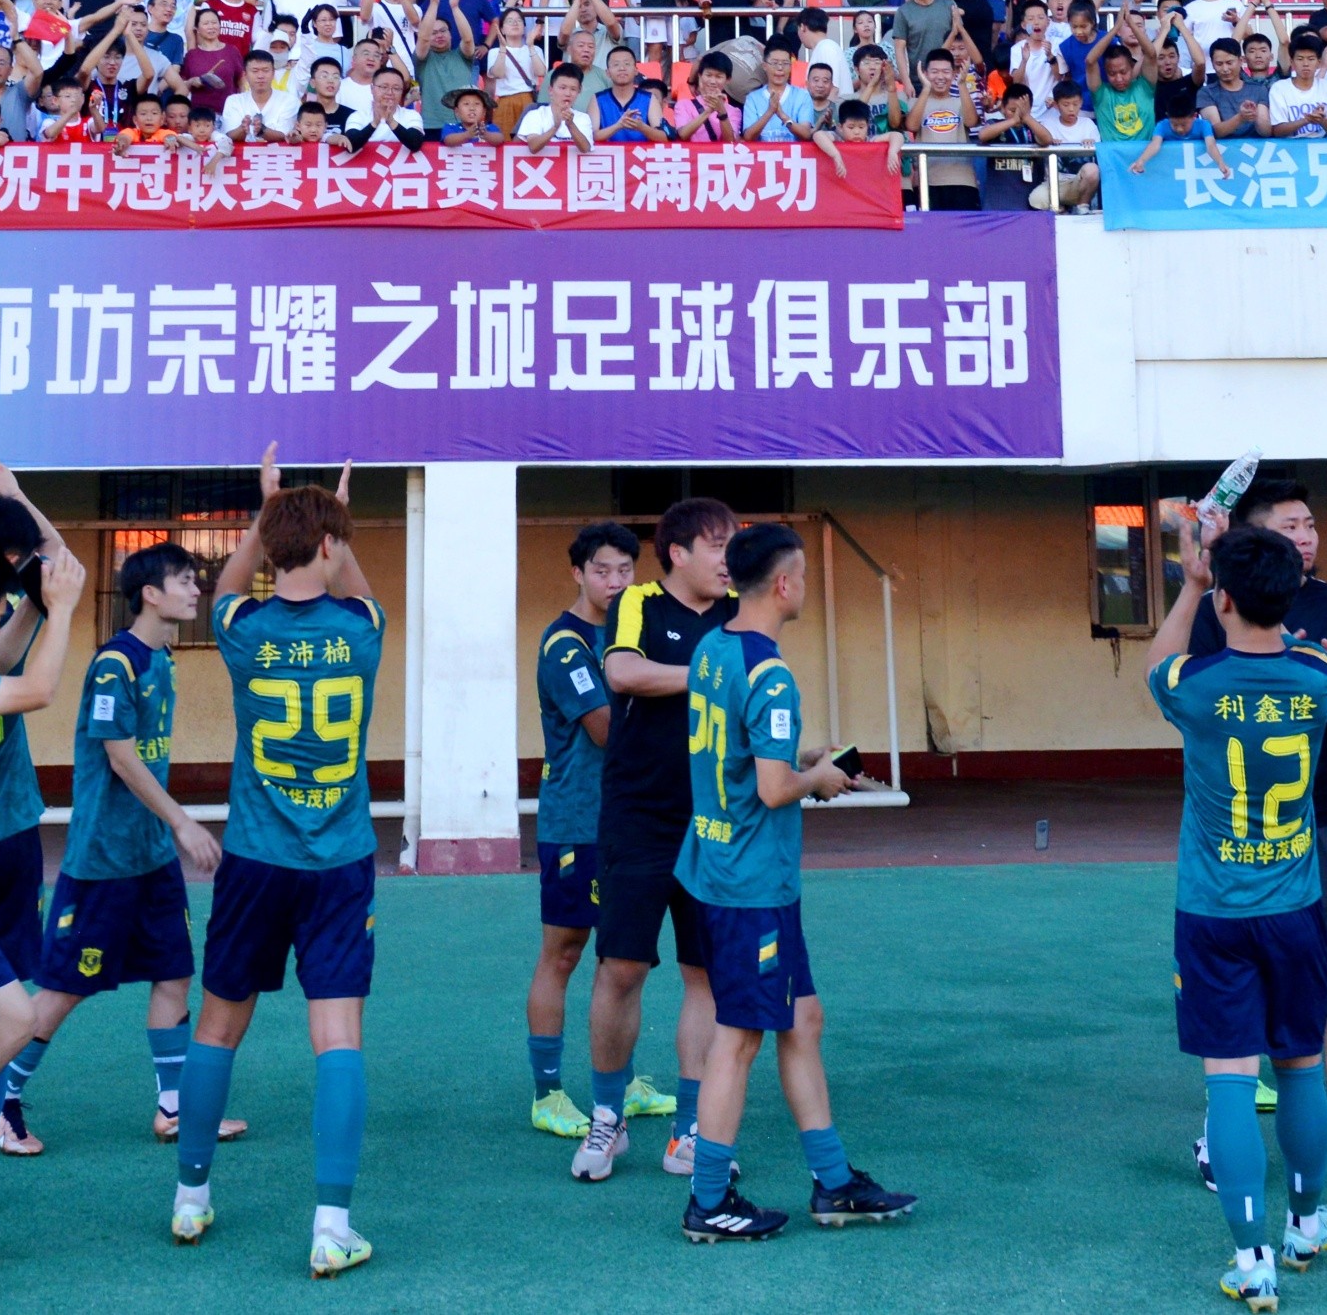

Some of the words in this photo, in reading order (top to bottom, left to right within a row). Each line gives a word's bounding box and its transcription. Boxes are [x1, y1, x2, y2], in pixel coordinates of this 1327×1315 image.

[925, 116, 961, 125] Dickies
[254, 636, 351, 669] 李沛楠
[1214, 693, 1318, 723] 利鑫隆
[248, 675, 364, 784] 29
[1226, 733, 1310, 840] 12
